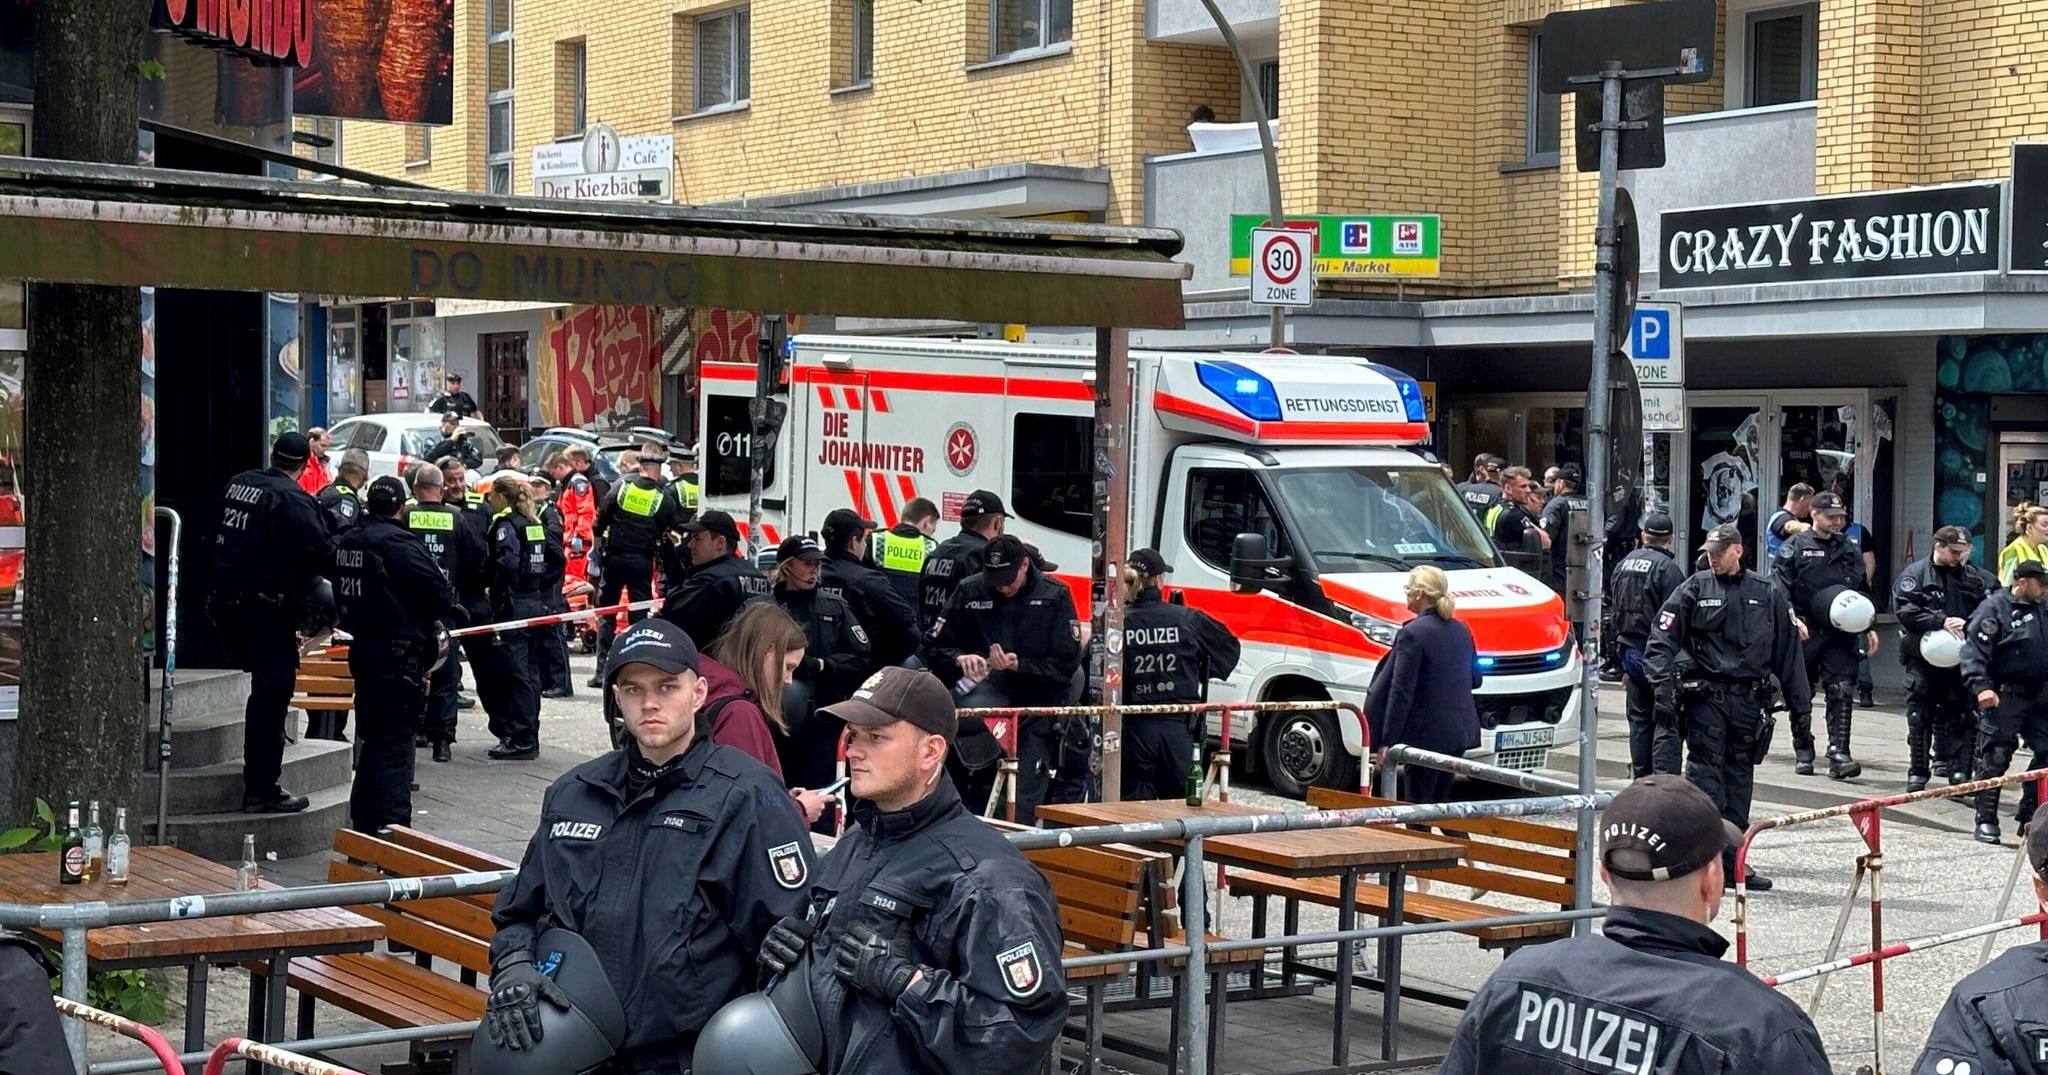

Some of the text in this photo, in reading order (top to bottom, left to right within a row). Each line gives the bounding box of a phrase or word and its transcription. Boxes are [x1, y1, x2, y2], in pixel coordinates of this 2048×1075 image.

[633, 151, 658, 166] Café
[541, 181, 570, 199] Der
[1669, 212, 1804, 275] CRAZY
[1808, 206, 1991, 266] FASHION
[1270, 249, 1294, 271] 30
[1313, 260, 1330, 273] ini
[1342, 260, 1391, 273] Market
[409, 249, 697, 301] DO MUNDO
[1266, 287, 1297, 300] ZONE
[1640, 316, 1661, 353] P
[1636, 365, 1668, 379] ZONE
[1285, 397, 1400, 414] RETTUNGSDIENST
[1643, 397, 1660, 408] mit
[823, 411, 849, 438] DIE
[733, 433, 751, 458] 11
[818, 440, 925, 474] JOHANNITER
[225, 483, 263, 505] POLIZEI
[223, 507, 249, 531] 2211
[410, 513, 450, 529] POLIZEI
[336, 549, 363, 569] POLIZEI
[887, 545, 922, 561] POLIZEI
[925, 558, 955, 577] POLIZEI
[1621, 559, 1652, 573] POLIZEI
[738, 575, 768, 595] POLIZEI
[1452, 589, 1503, 599] ANNITER
[625, 628, 664, 645] POLIZEI
[1125, 626, 1180, 646] POLIZEI
[1134, 653, 1177, 675] 2212
[1135, 683, 1152, 695] SH
[550, 822, 602, 840] POLIZEI
[1604, 822, 1667, 853] POLIZEI
[772, 846, 798, 859] POLIZEI
[872, 895, 897, 911] 21243
[1001, 947, 1030, 964] POLIZEI
[1514, 989, 1660, 1075] POLIZEI
